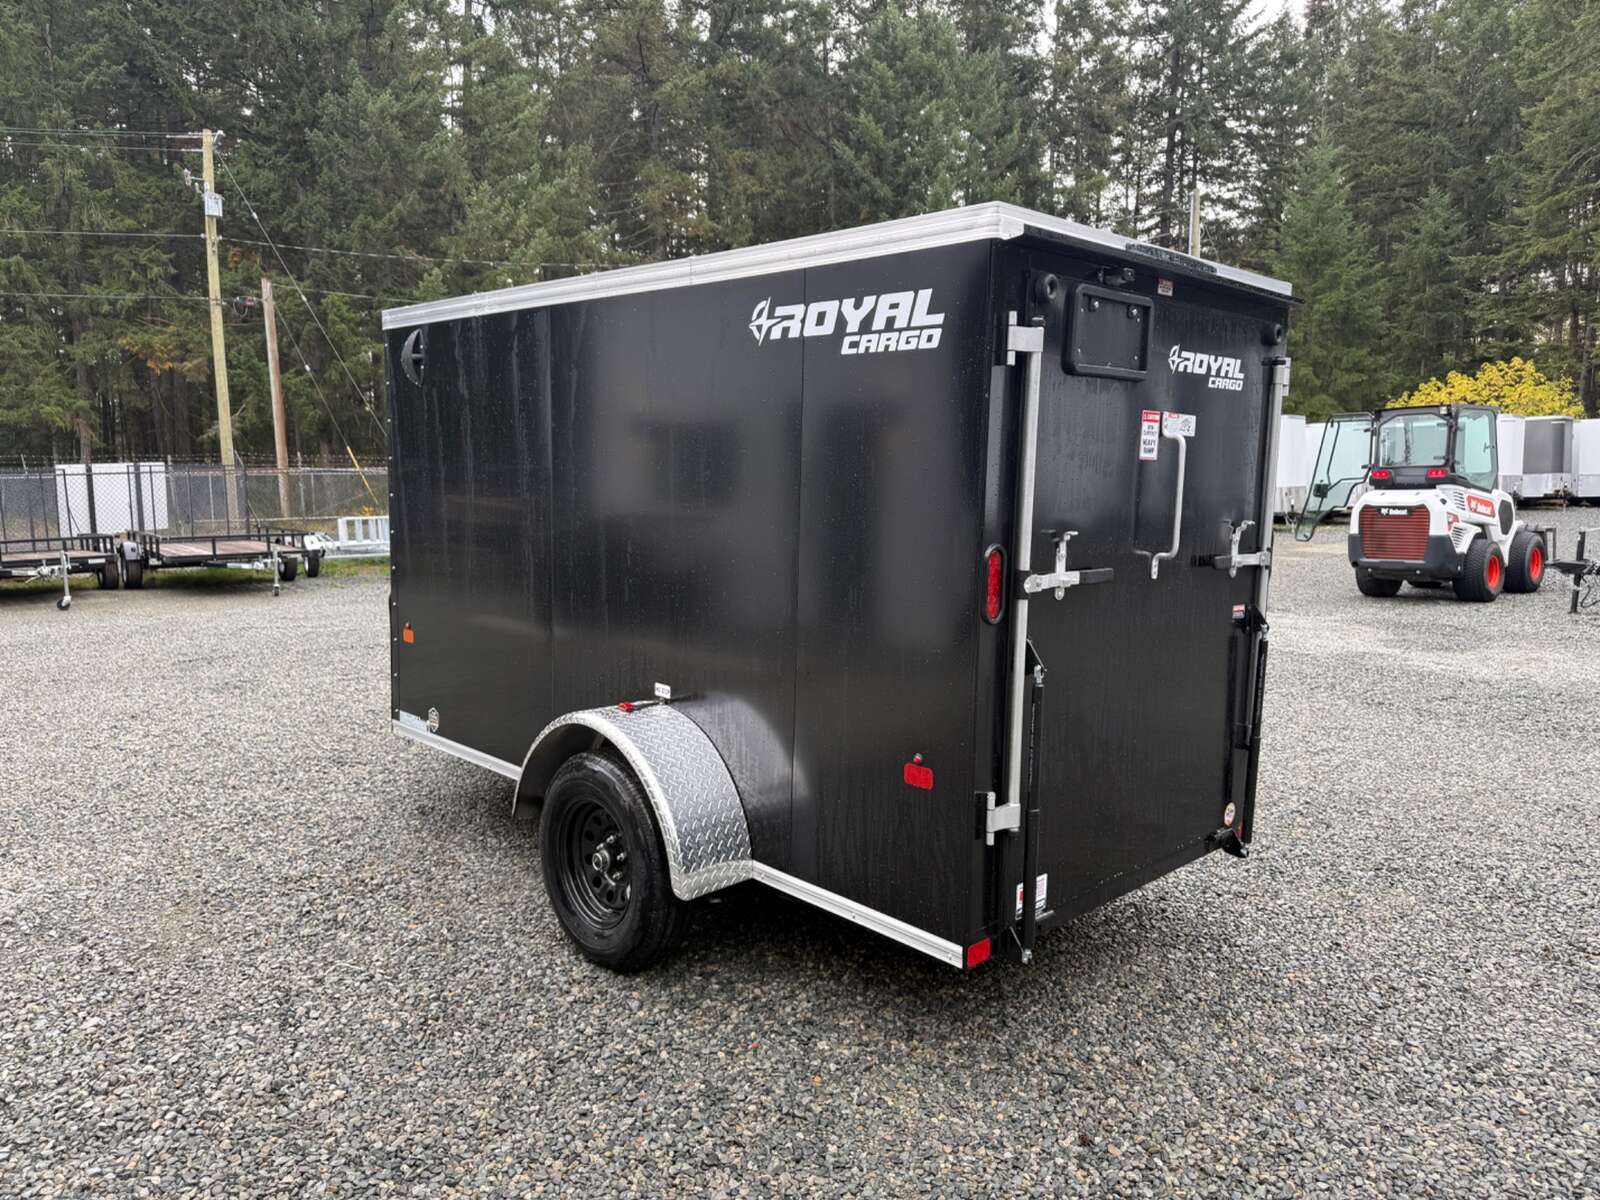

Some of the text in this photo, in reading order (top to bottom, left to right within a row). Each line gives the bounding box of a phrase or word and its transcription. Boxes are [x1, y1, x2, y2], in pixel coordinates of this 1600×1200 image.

[769, 288, 945, 340] ROYAL
[841, 328, 943, 355] CARGO
[1178, 351, 1245, 379] ROYAL
[1208, 377, 1243, 391] CARGO
